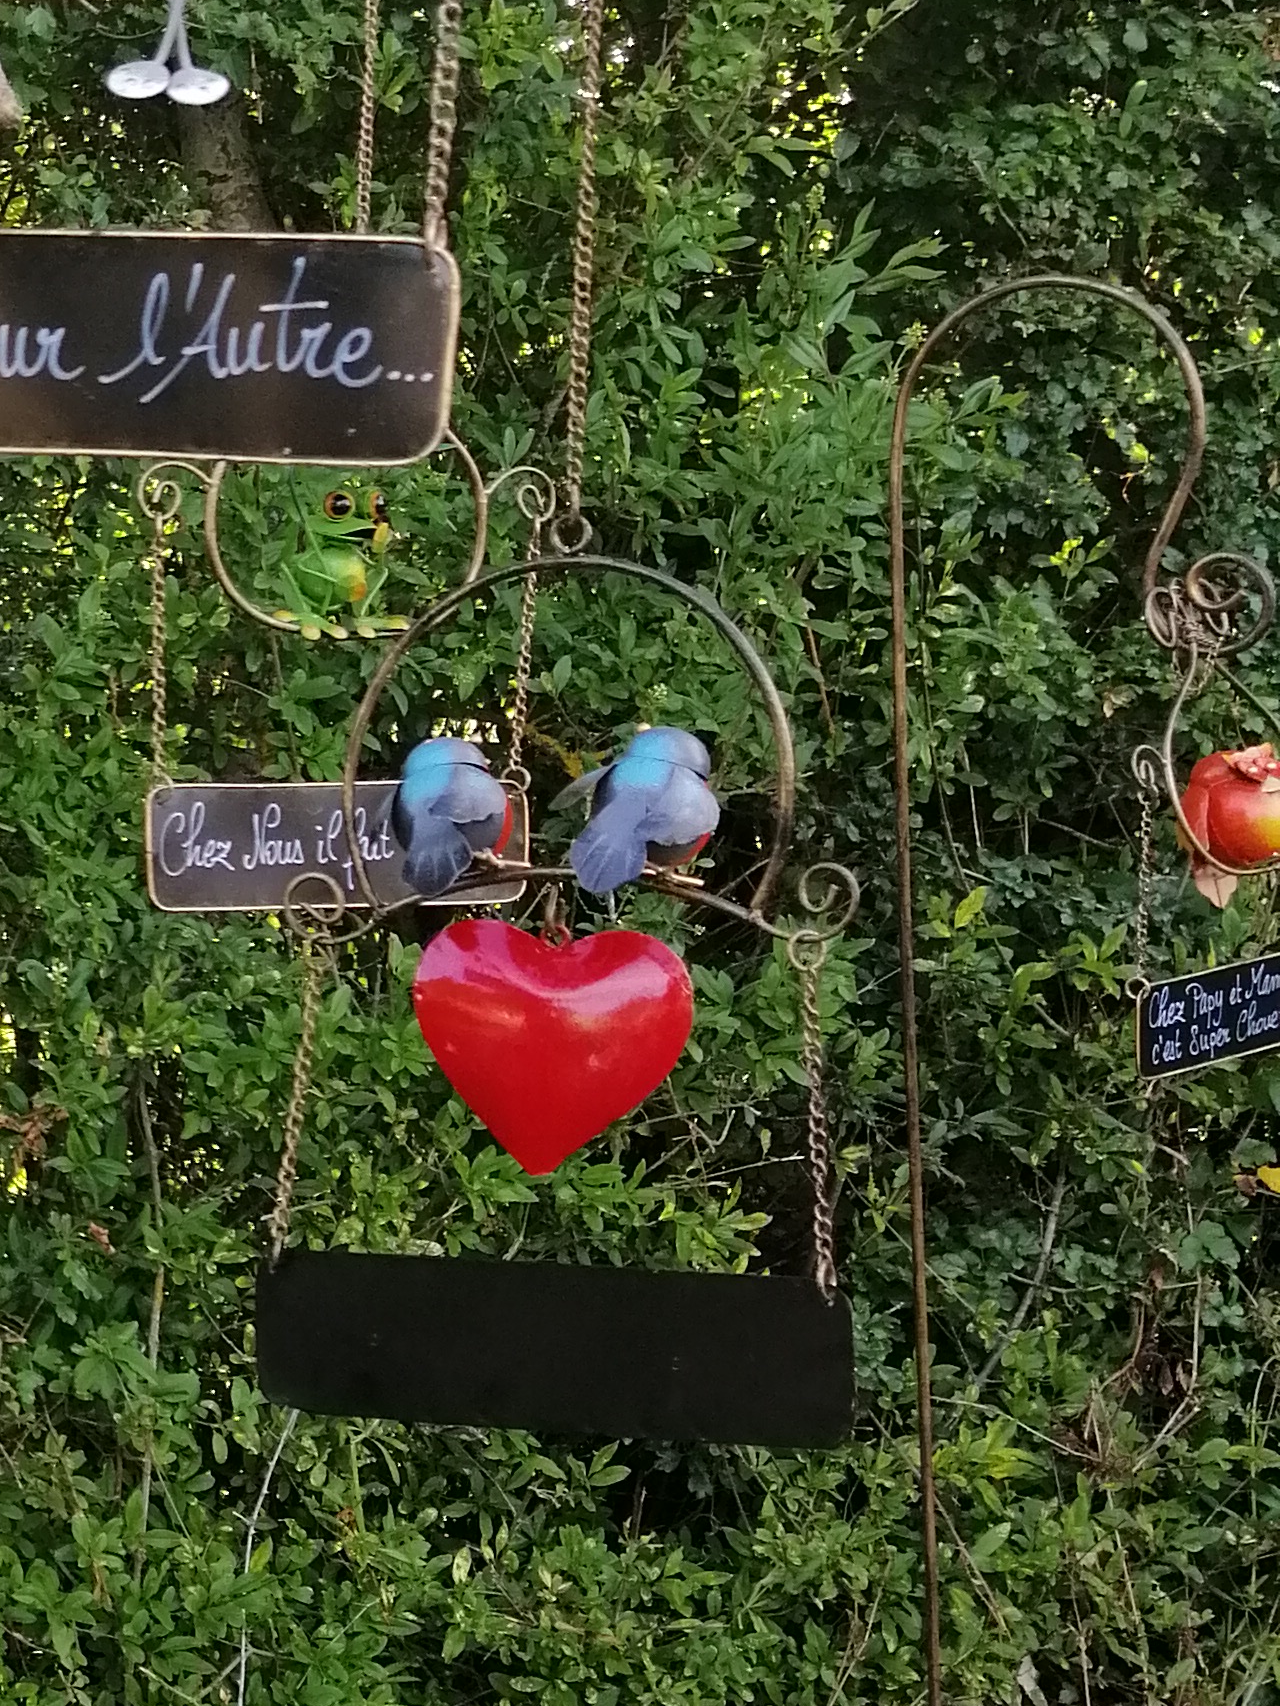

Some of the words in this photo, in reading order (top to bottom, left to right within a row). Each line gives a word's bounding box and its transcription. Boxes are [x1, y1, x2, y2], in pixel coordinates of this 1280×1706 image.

[159, 801, 235, 877] Chez
[242, 802, 305, 870] Nous
[314, 809, 343, 864] il
[1149, 985, 1187, 1028] Chez
[1185, 983, 1223, 1029] Papy
[1229, 973, 1243, 1005] et
[1152, 1028, 1182, 1065] c'est
[1189, 1025, 1231, 1059] Super
[1236, 1000, 1280, 1042] Choue
